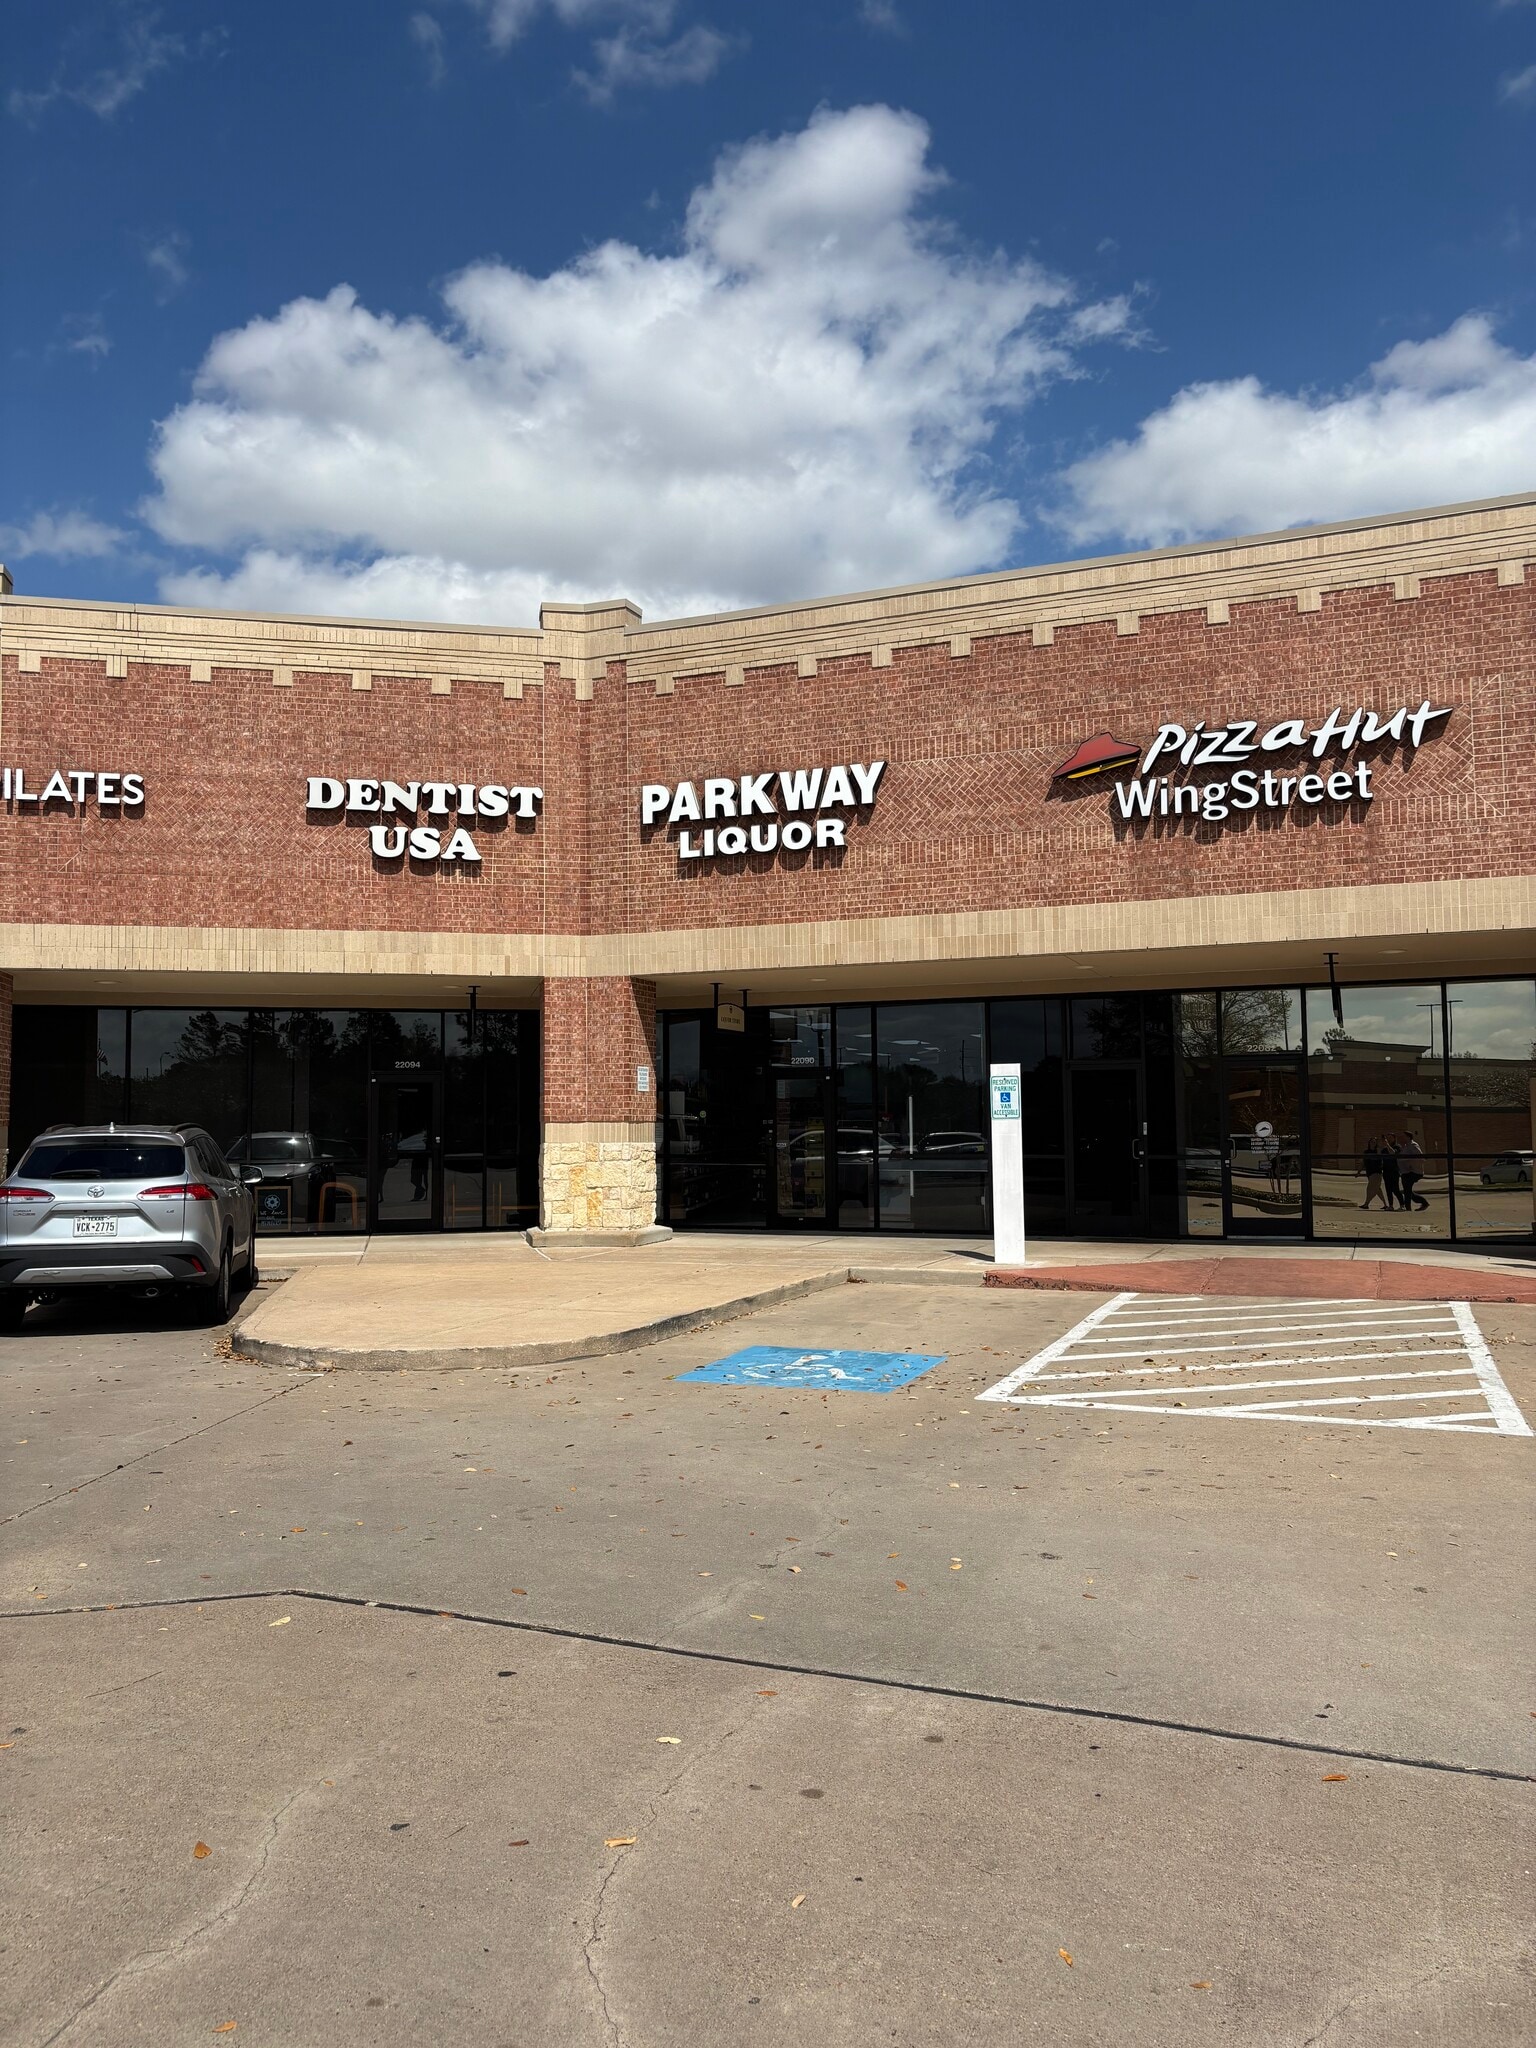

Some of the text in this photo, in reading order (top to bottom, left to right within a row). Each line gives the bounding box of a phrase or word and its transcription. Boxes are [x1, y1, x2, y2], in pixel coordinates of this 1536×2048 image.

[1142, 700, 1454, 774] Pizza Hut
[305, 777, 543, 818] DENTIST
[641, 761, 886, 824] PARKWAY
[1115, 761, 1374, 821] WingStreet
[370, 825, 482, 861] USA
[678, 819, 847, 859] LIQUOR
